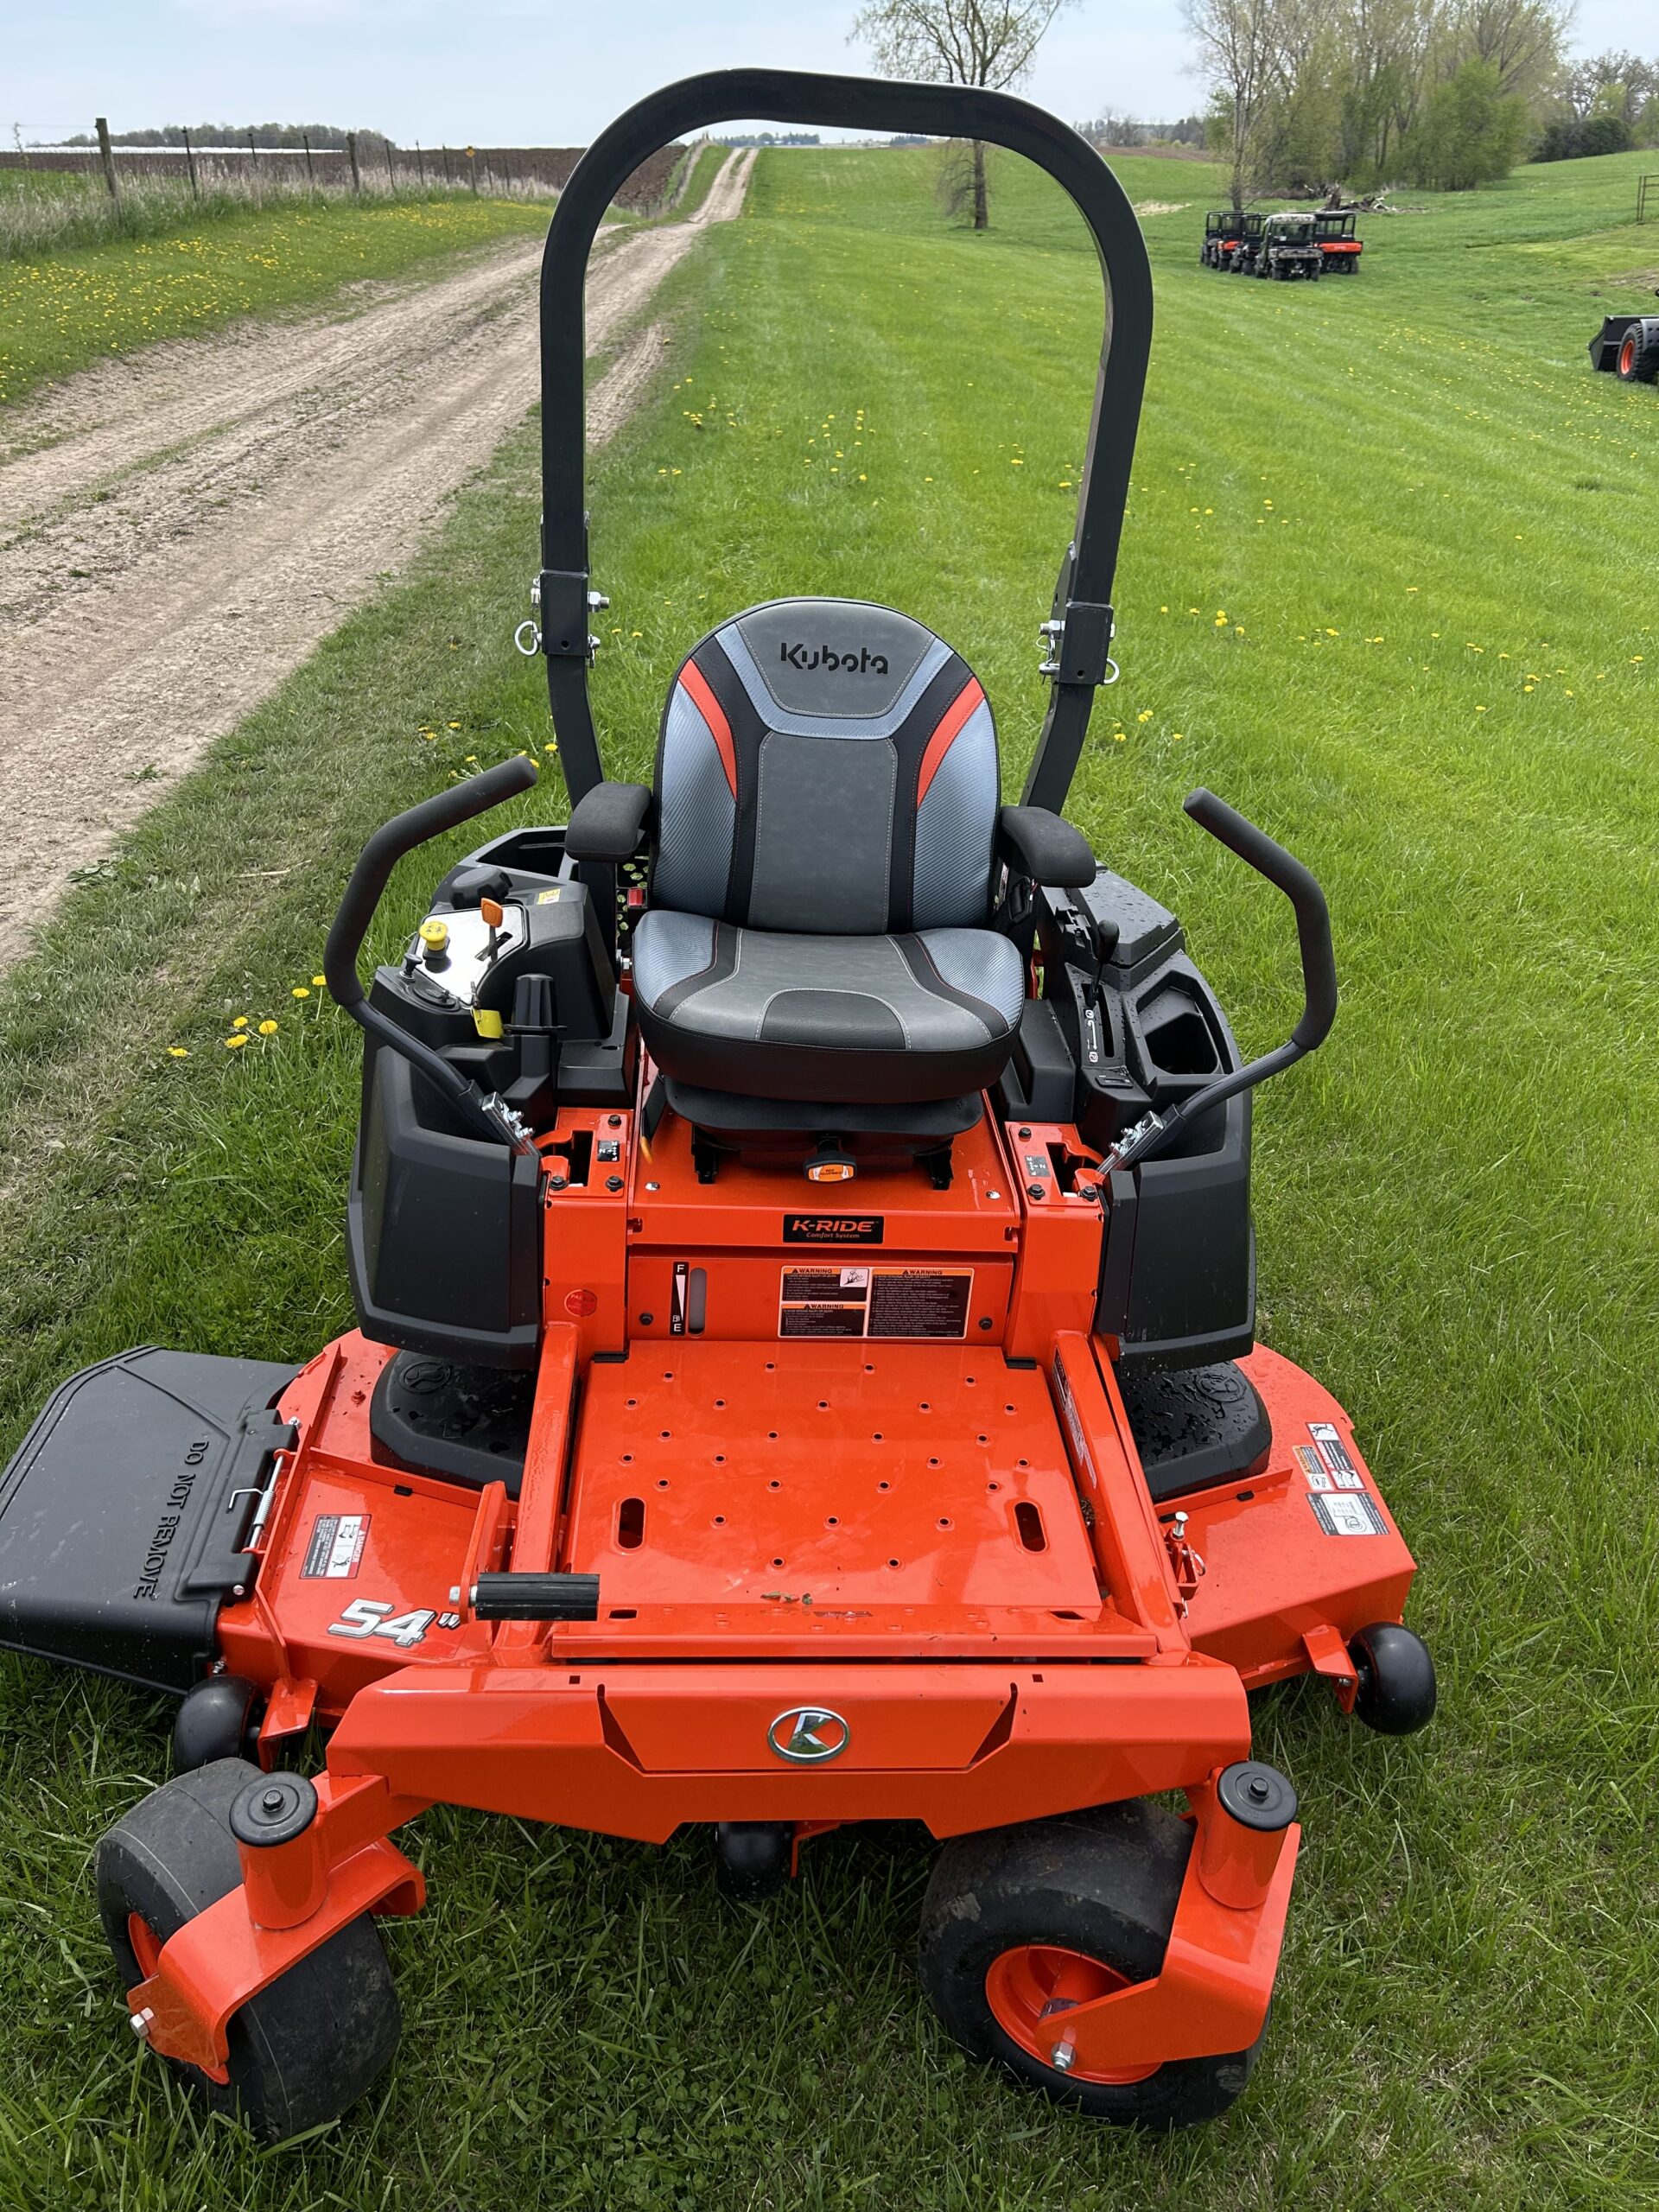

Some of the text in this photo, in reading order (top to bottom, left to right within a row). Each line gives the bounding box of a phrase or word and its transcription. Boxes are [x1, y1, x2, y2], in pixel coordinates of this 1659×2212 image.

[780, 642, 889, 675] Kubota
[791, 1219, 875, 1232] K-RIDE
[677, 1264, 685, 1273] F
[673, 1323, 682, 1332] E
[133, 1440, 210, 1599] DO NOT REMOVE
[352, 1535, 365, 1562] DANGER
